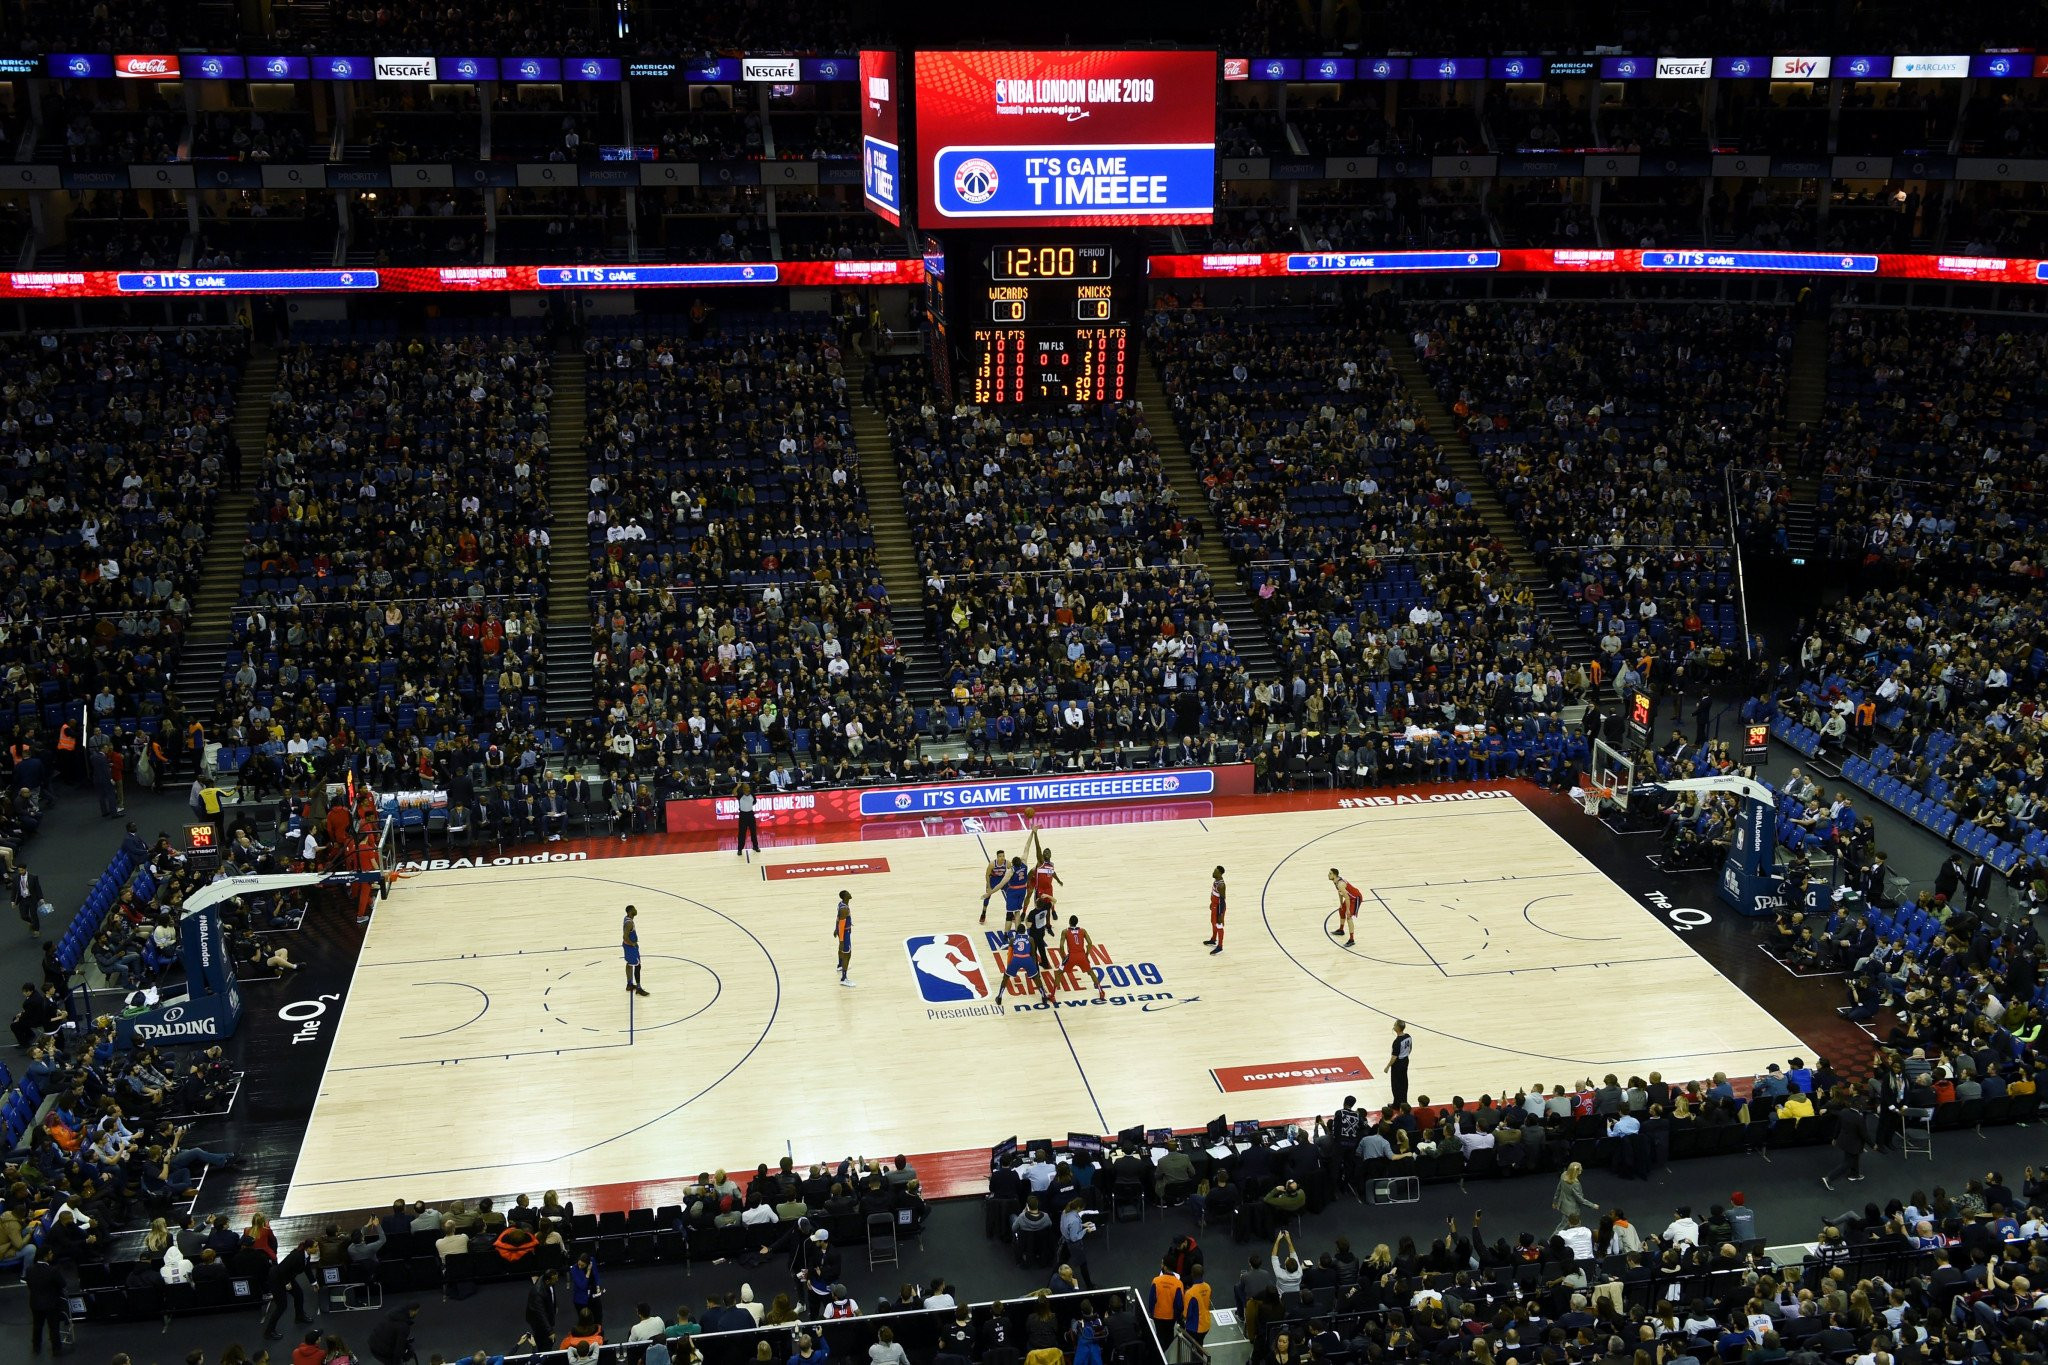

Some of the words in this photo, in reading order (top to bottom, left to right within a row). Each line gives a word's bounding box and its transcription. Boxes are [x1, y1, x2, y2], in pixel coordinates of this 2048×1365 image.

[128, 59, 168, 73] Coca-Cola
[379, 61, 431, 76] NESCAFÉ
[746, 62, 794, 77] NESCAFÉ
[1660, 61, 1707, 75] NESCAFÉ
[1784, 58, 1817, 77] sky
[1915, 63, 1956, 71] BARCLAYS
[1008, 80, 1034, 103] NBA
[1036, 80, 1086, 103] LONDON
[1087, 79, 1121, 103] GAME
[1123, 79, 1154, 103] 2019
[1025, 158, 1061, 176] IT'S
[1067, 157, 1127, 175] GAME
[338, 173, 378, 181] PRIORITY
[1007, 248, 1074, 276] 12:00
[1078, 248, 1105, 257] PERIOD
[1092, 260, 1097, 274] 1
[989, 286, 1029, 299] WIZARDS
[1077, 285, 1112, 298] KNICKS
[1011, 303, 1022, 320] 0
[1097, 301, 1107, 318] 0
[975, 331, 991, 341] PLY
[995, 330, 1006, 340] FL
[1008, 330, 1025, 340] PTS
[1077, 329, 1093, 339] PLY
[1096, 329, 1107, 339] FL
[1109, 328, 1126, 338] PTS
[987, 343, 991, 351] 1
[997, 341, 1005, 351] 0
[1017, 341, 1024, 351] 0
[1038, 342, 1050, 351] TM
[1051, 342, 1064, 351] FLS
[1088, 341, 1092, 349] 1
[1098, 339, 1106, 349] 0
[1118, 339, 1125, 349] 0
[984, 354, 990, 364] 3
[997, 352, 1005, 364] 0
[1017, 352, 1024, 364] 0
[1040, 355, 1048, 366] 0
[1061, 354, 1069, 365] 0
[1084, 353, 1092, 362] 2
[1098, 351, 1106, 362] 0
[1117, 351, 1125, 362] 0
[978, 368, 990, 377] 13
[997, 366, 1004, 377] 0
[1016, 366, 1023, 377] 0
[1084, 366, 1092, 375] 3
[1098, 364, 1105, 375] 0
[1117, 364, 1124, 375] 0
[975, 380, 990, 390] 31
[996, 378, 1004, 390] 0
[1016, 378, 1023, 390] 0
[1041, 374, 1061, 382] T.O.L.
[1075, 378, 1091, 388] 20
[1097, 376, 1105, 388] 0
[1116, 376, 1123, 388] 0
[975, 393, 990, 402] 32
[996, 391, 1004, 402] 0
[1015, 391, 1023, 402] 0
[1041, 386, 1047, 396] 7
[1062, 386, 1068, 396] 7
[1076, 391, 1091, 400] 32
[1097, 389, 1104, 400] 0
[1116, 389, 1123, 400] 0
[1634, 704, 1648, 724] 24
[1749, 735, 1763, 745] 24
[723, 799, 740, 814] NBA
[773, 795, 795, 810] GAME
[795, 795, 815, 809] 2019
[923, 791, 955, 808] IT'S
[959, 788, 1011, 805] GAME
[1338, 789, 1513, 809] #NBALondon
[191, 826, 212, 836] 12:00
[193, 836, 209, 847] 24
[786, 863, 869, 875] norwegian
[1644, 890, 1673, 909] The
[1754, 891, 1817, 911] SPALG
[199, 915, 210, 967] #NBALondon
[1092, 962, 1164, 989] 2019
[926, 1006, 991, 1020] Presented
[992, 1003, 1005, 1016] by
[1013, 992, 1174, 1012] norwegian
[134, 1017, 216, 1040] SPALDING
[292, 1020, 321, 1044] The
[1242, 1066, 1344, 1081] norwegian
